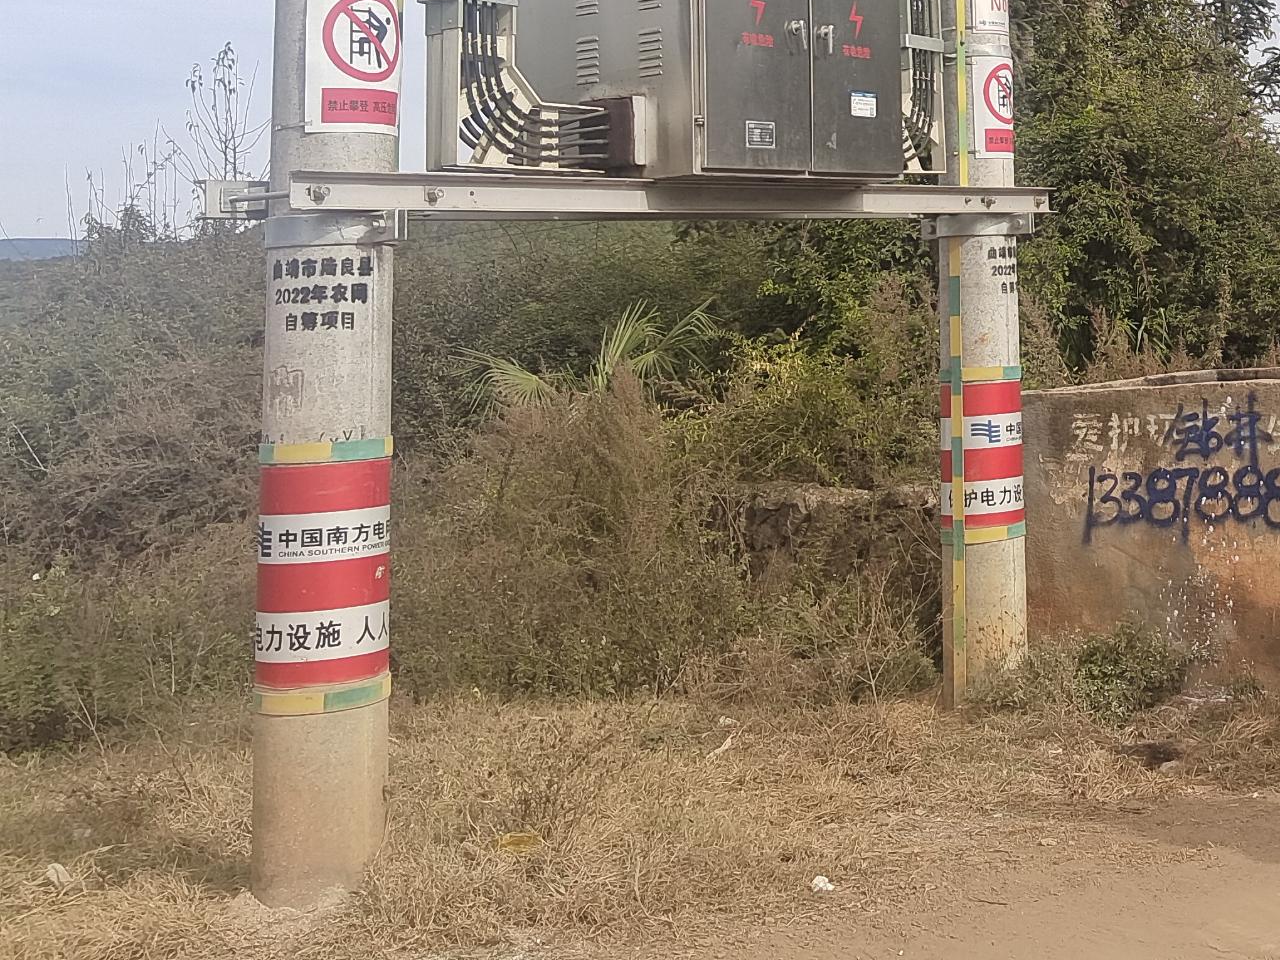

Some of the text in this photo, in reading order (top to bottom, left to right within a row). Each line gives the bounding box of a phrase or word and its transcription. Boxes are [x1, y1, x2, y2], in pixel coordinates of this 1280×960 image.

[328, 100, 369, 112] 禁止攀登
[273, 257, 374, 280] 曲靖市陆良县
[275, 283, 368, 305] 2022年农网
[286, 311, 355, 331] 自筹项目
[949, 484, 1023, 508] 护电力设
[278, 550, 305, 558] CHINA
[307, 546, 360, 556] SOUTHERN
